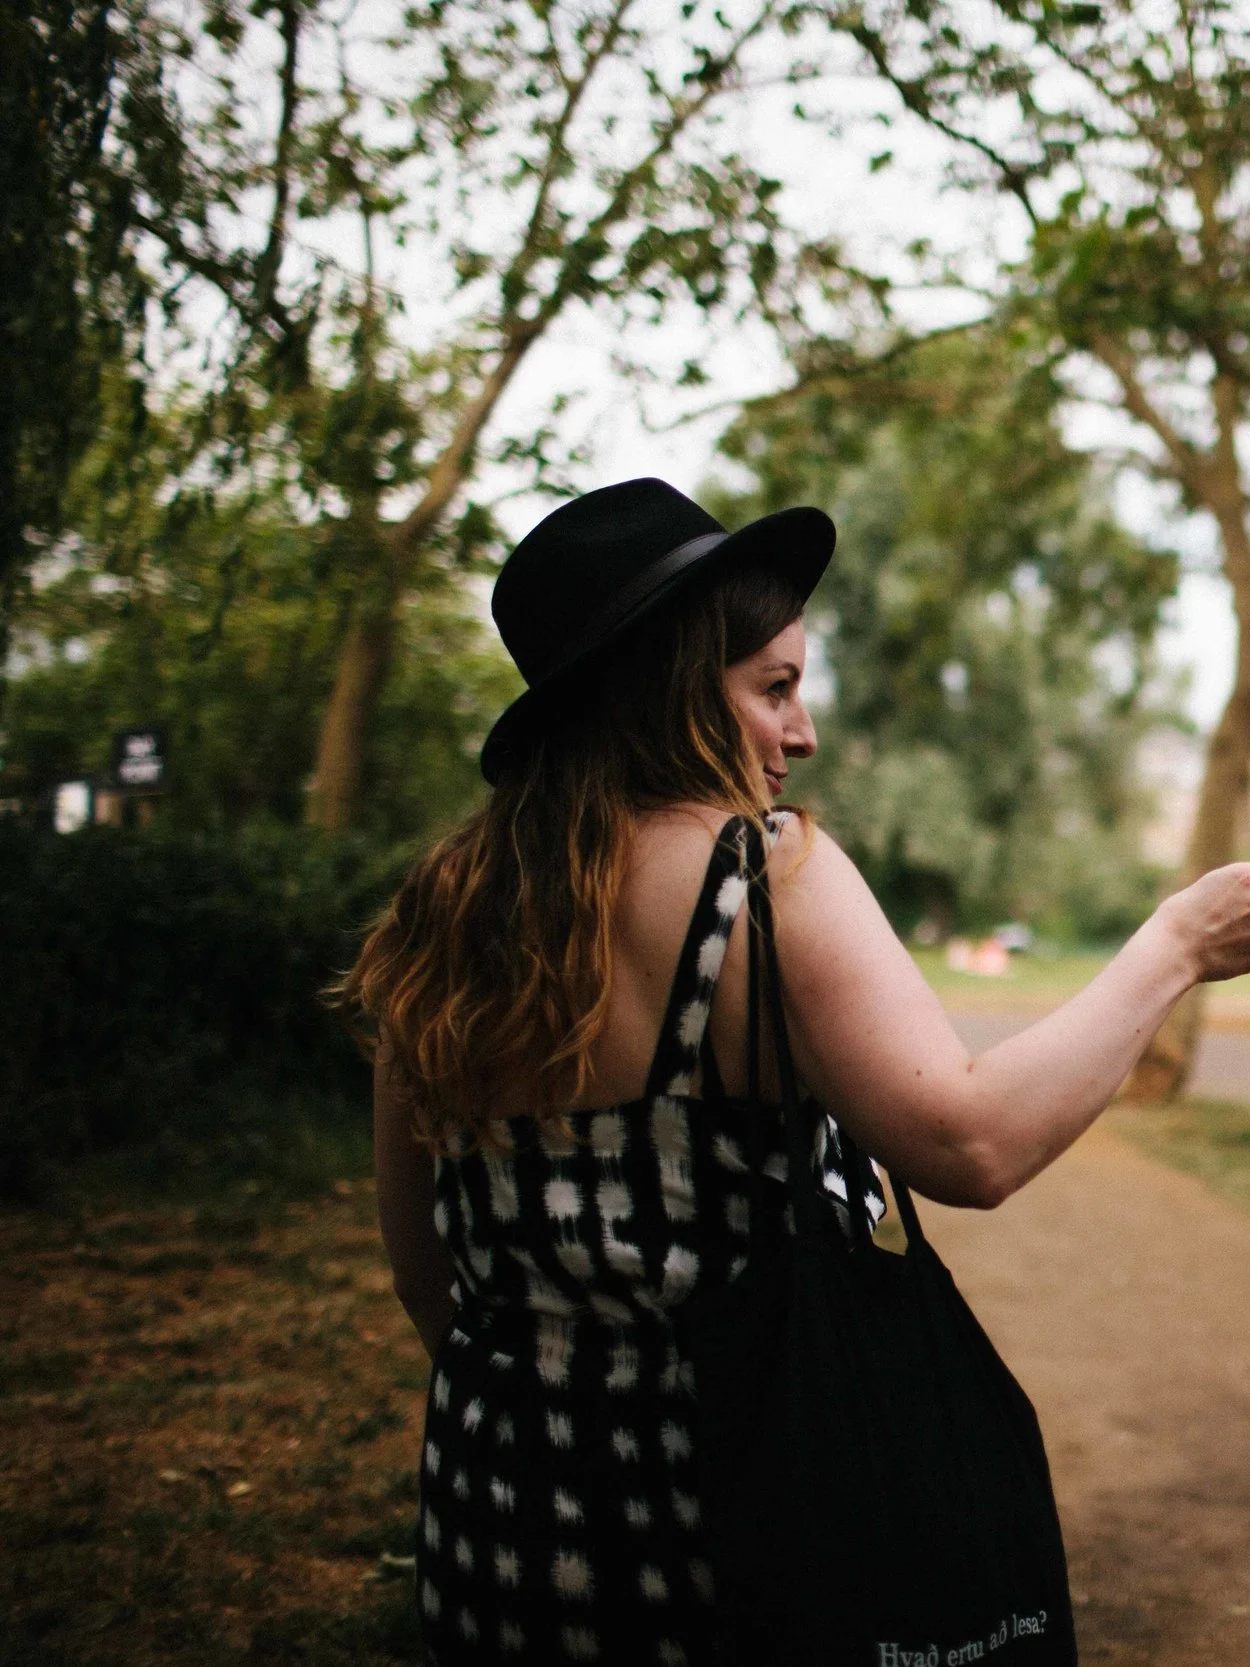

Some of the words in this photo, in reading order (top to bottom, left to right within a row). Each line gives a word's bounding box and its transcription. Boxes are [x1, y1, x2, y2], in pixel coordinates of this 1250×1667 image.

[877, 1643, 939, 1667] Hvað
[947, 1640, 984, 1667] ertu
[989, 1619, 1008, 1651] að
[1011, 1610, 1047, 1638] lesa?
